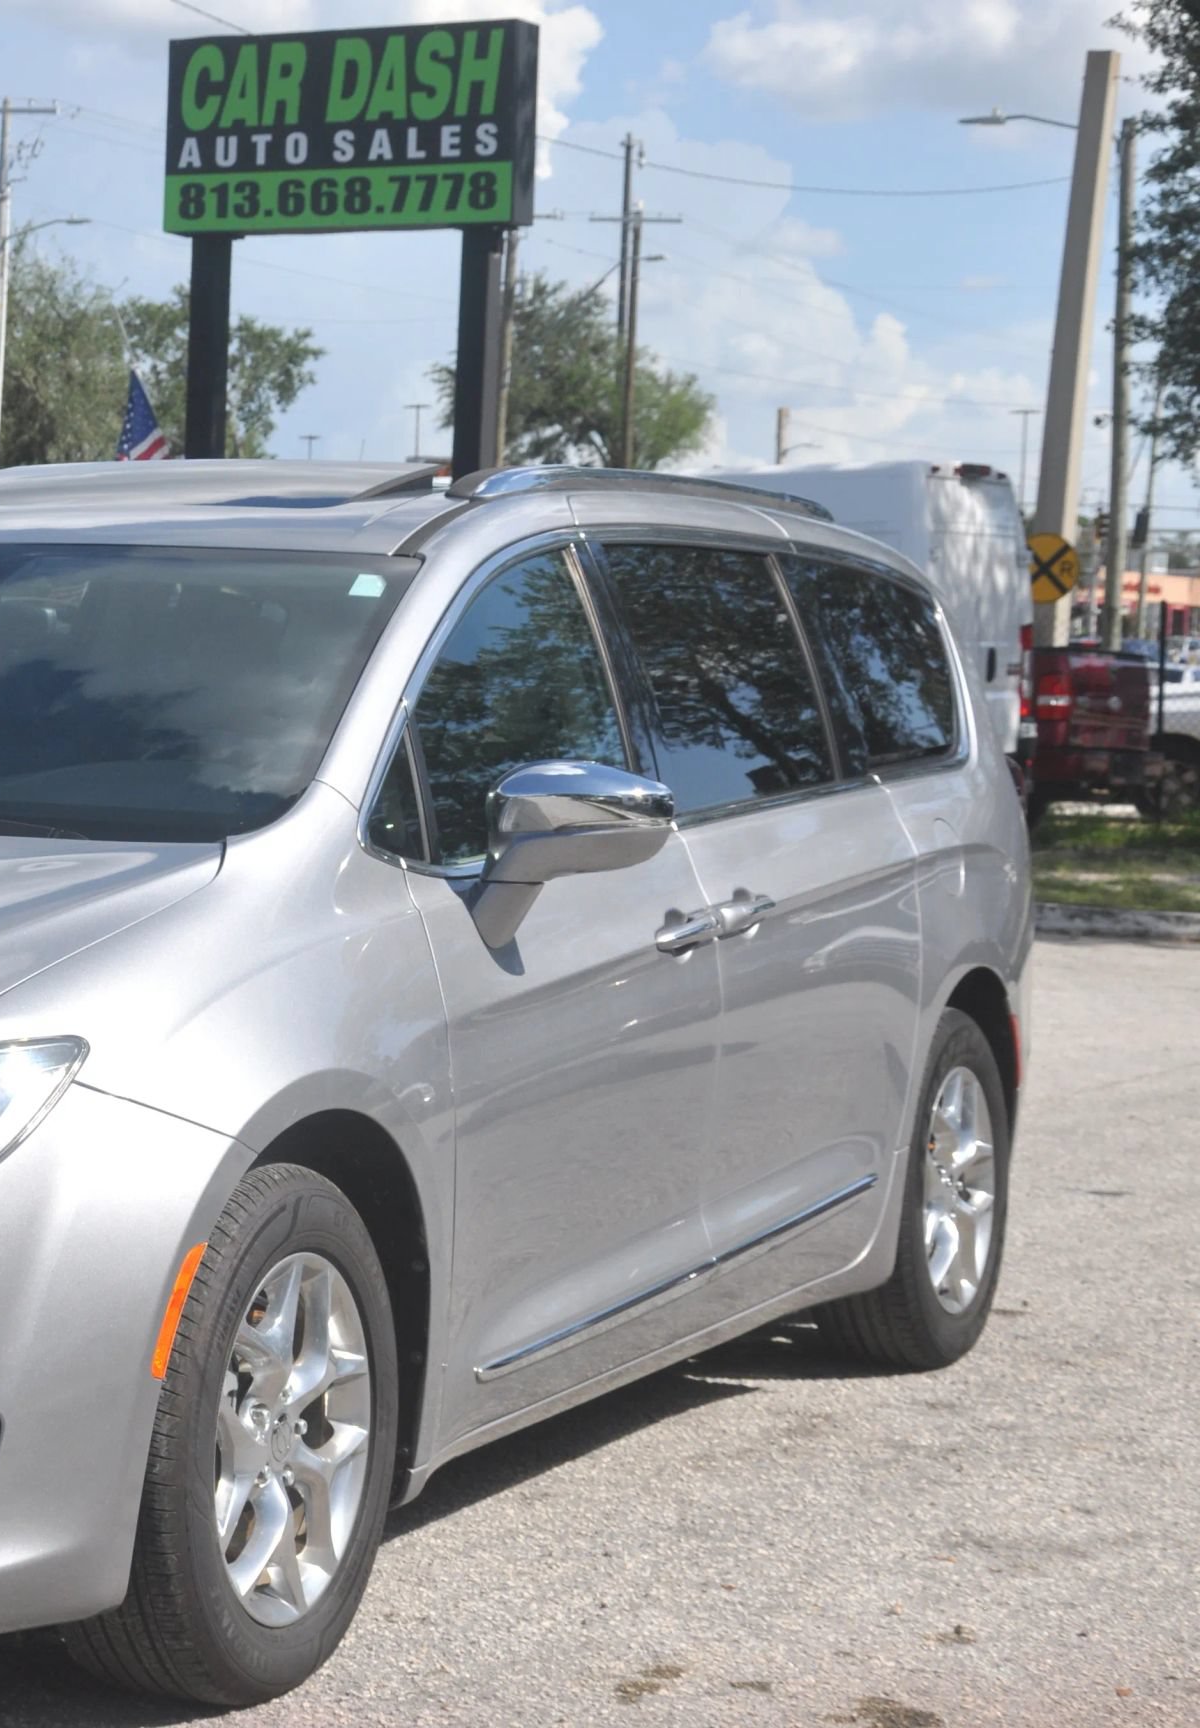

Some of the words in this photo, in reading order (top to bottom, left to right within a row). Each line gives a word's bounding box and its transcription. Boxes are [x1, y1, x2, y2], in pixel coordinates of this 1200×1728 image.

[180, 41, 308, 131] CAR
[325, 28, 506, 124] DASH
[178, 132, 309, 169] AUTO
[332, 122, 499, 163] SALES
[178, 170, 498, 221] 813.668.7778
